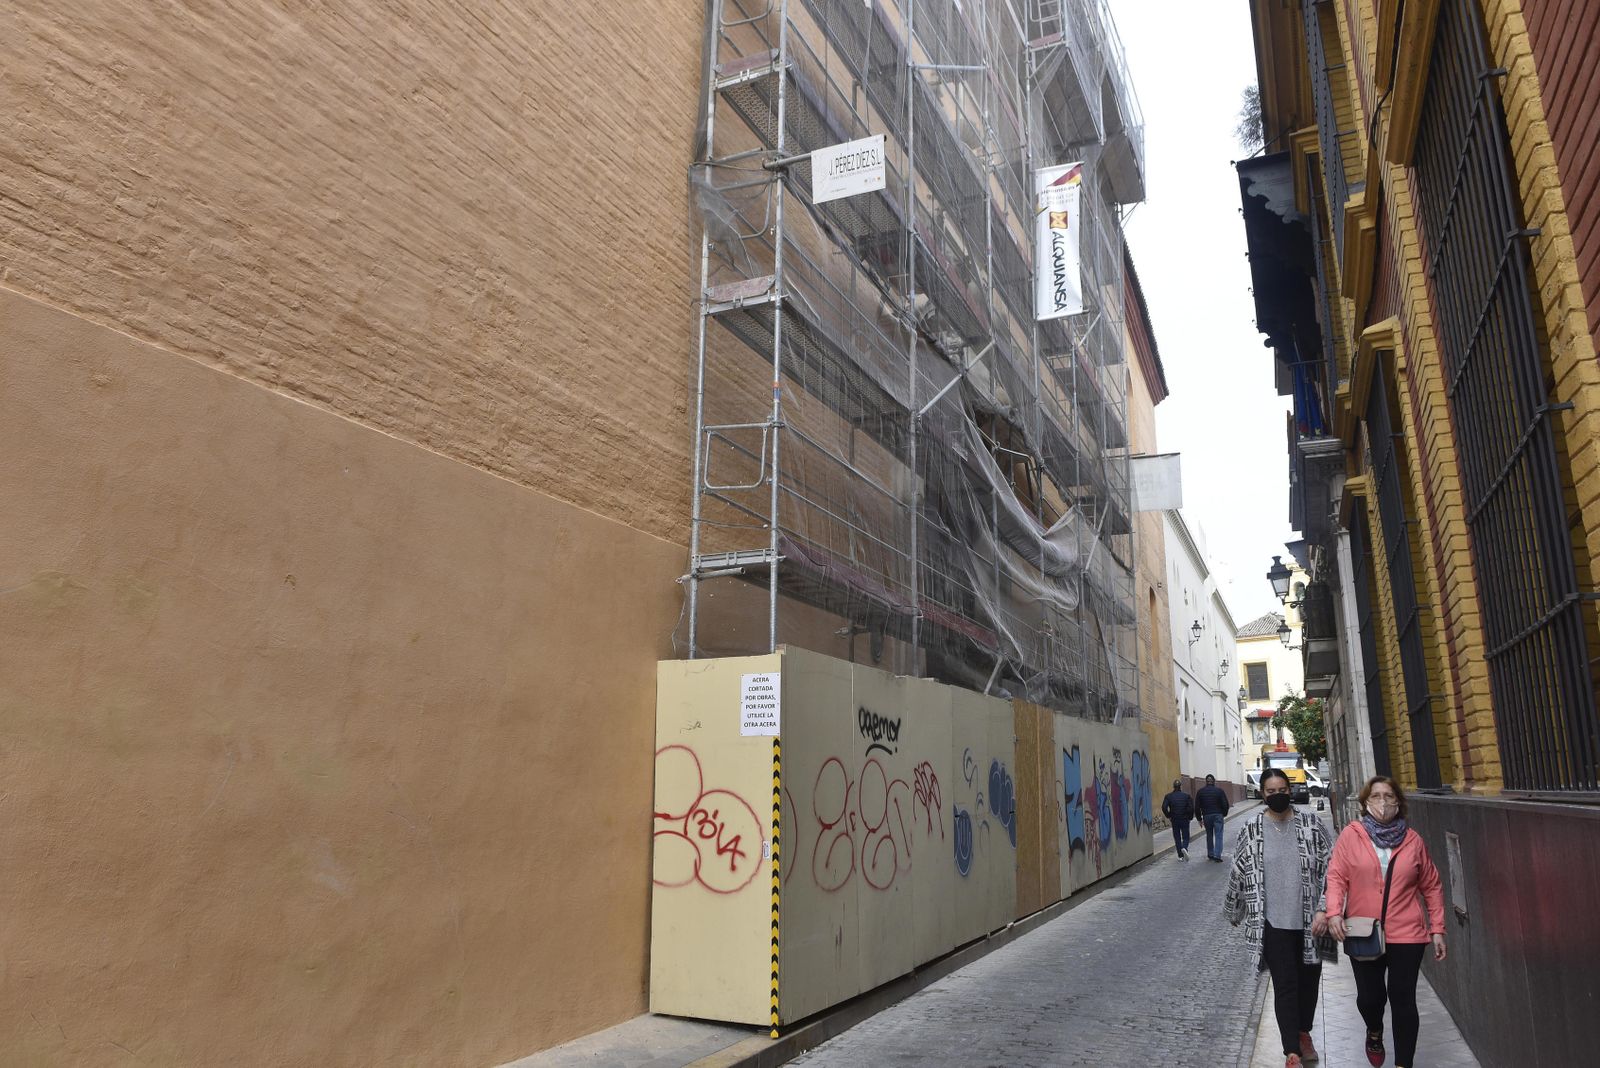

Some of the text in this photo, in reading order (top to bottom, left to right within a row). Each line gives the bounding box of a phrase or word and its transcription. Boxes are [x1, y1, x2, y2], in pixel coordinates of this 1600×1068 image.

[835, 152, 855, 175] PÉREZ
[856, 148, 870, 170] DÍEZ
[1052, 231, 1067, 313] ALQUIANSA
